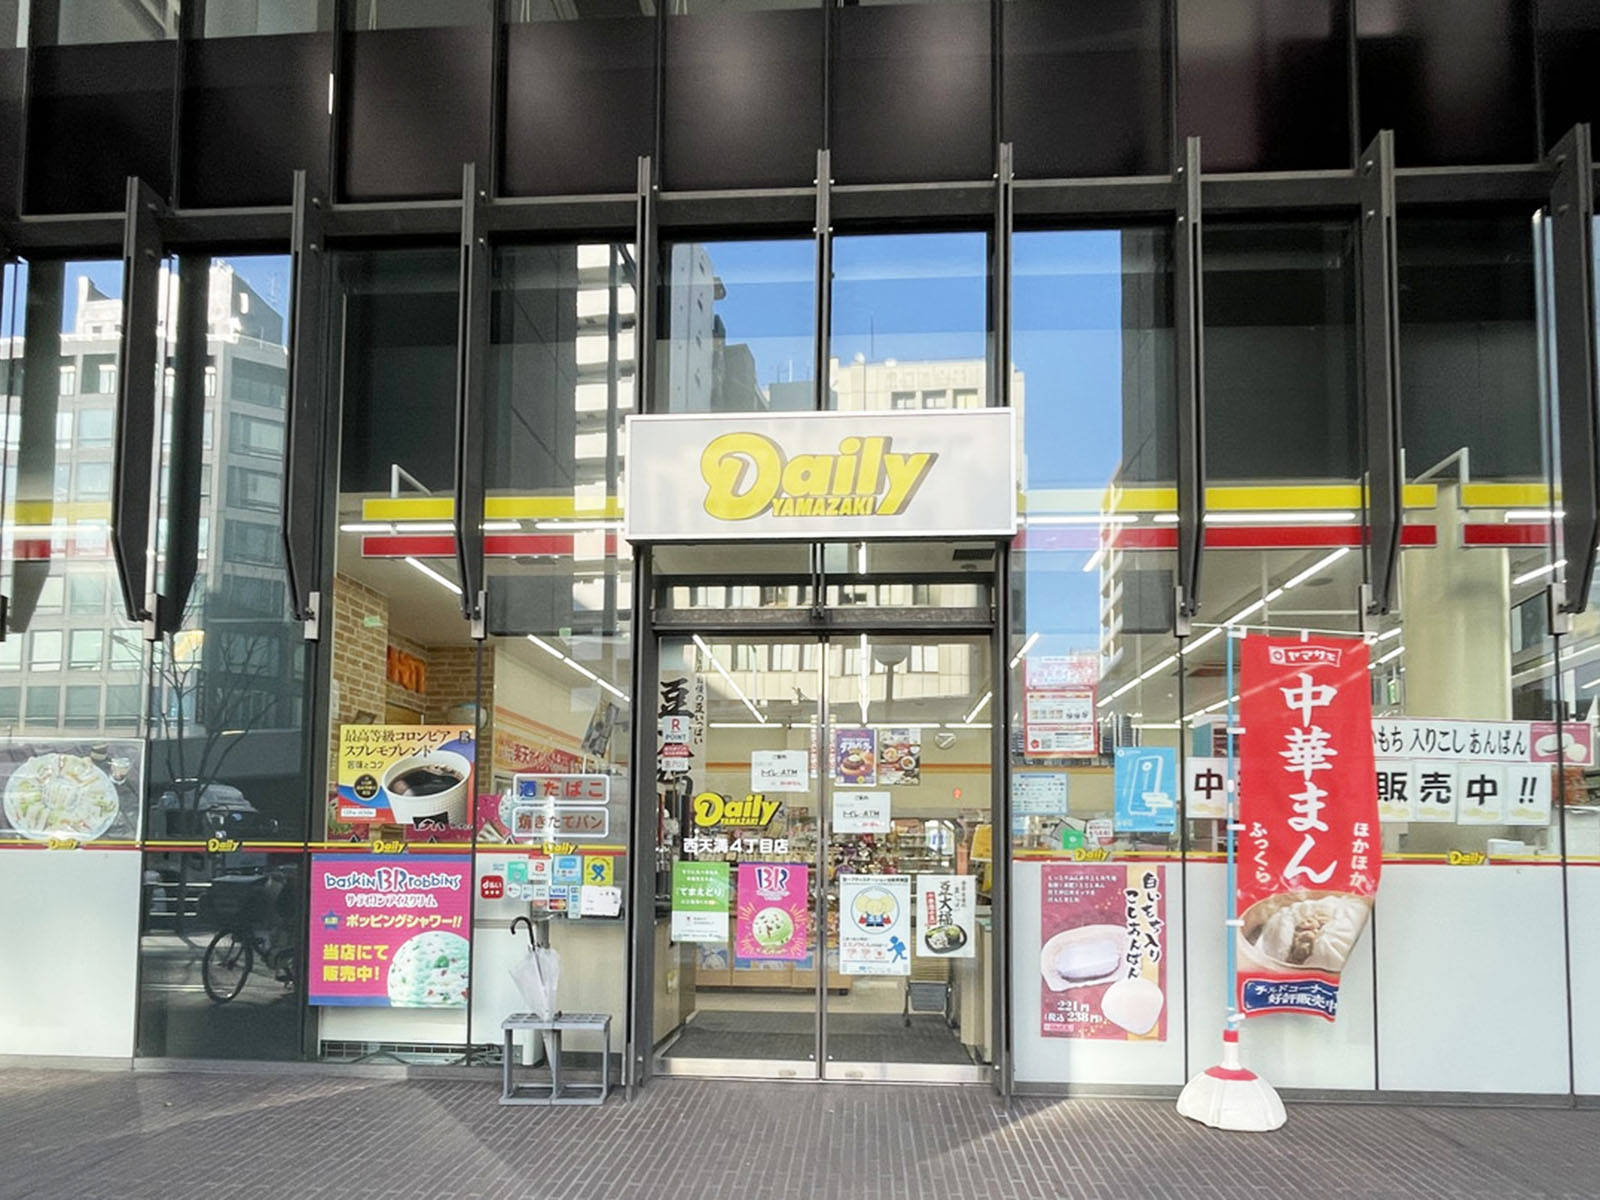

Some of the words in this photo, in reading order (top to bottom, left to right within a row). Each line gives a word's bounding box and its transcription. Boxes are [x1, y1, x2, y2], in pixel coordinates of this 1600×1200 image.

[700, 432, 938, 521] Daily
[771, 496, 877, 518] YAMAZAKI
[665, 733, 687, 741] POINT
[1278, 672, 1339, 884] 中華まん
[544, 780, 603, 797] たばこ
[693, 792, 782, 827] Daily
[518, 813, 603, 830] 焼きたてパン
[208, 839, 242, 852] Daily
[373, 840, 409, 853] Daily
[1248, 822, 1270, 884] ふっくら
[1074, 847, 1111, 862] Daily
[1450, 850, 1486, 865] Daily
[325, 872, 376, 889] baskin
[408, 874, 462, 890] robbins
[322, 943, 390, 961] 当店にて
